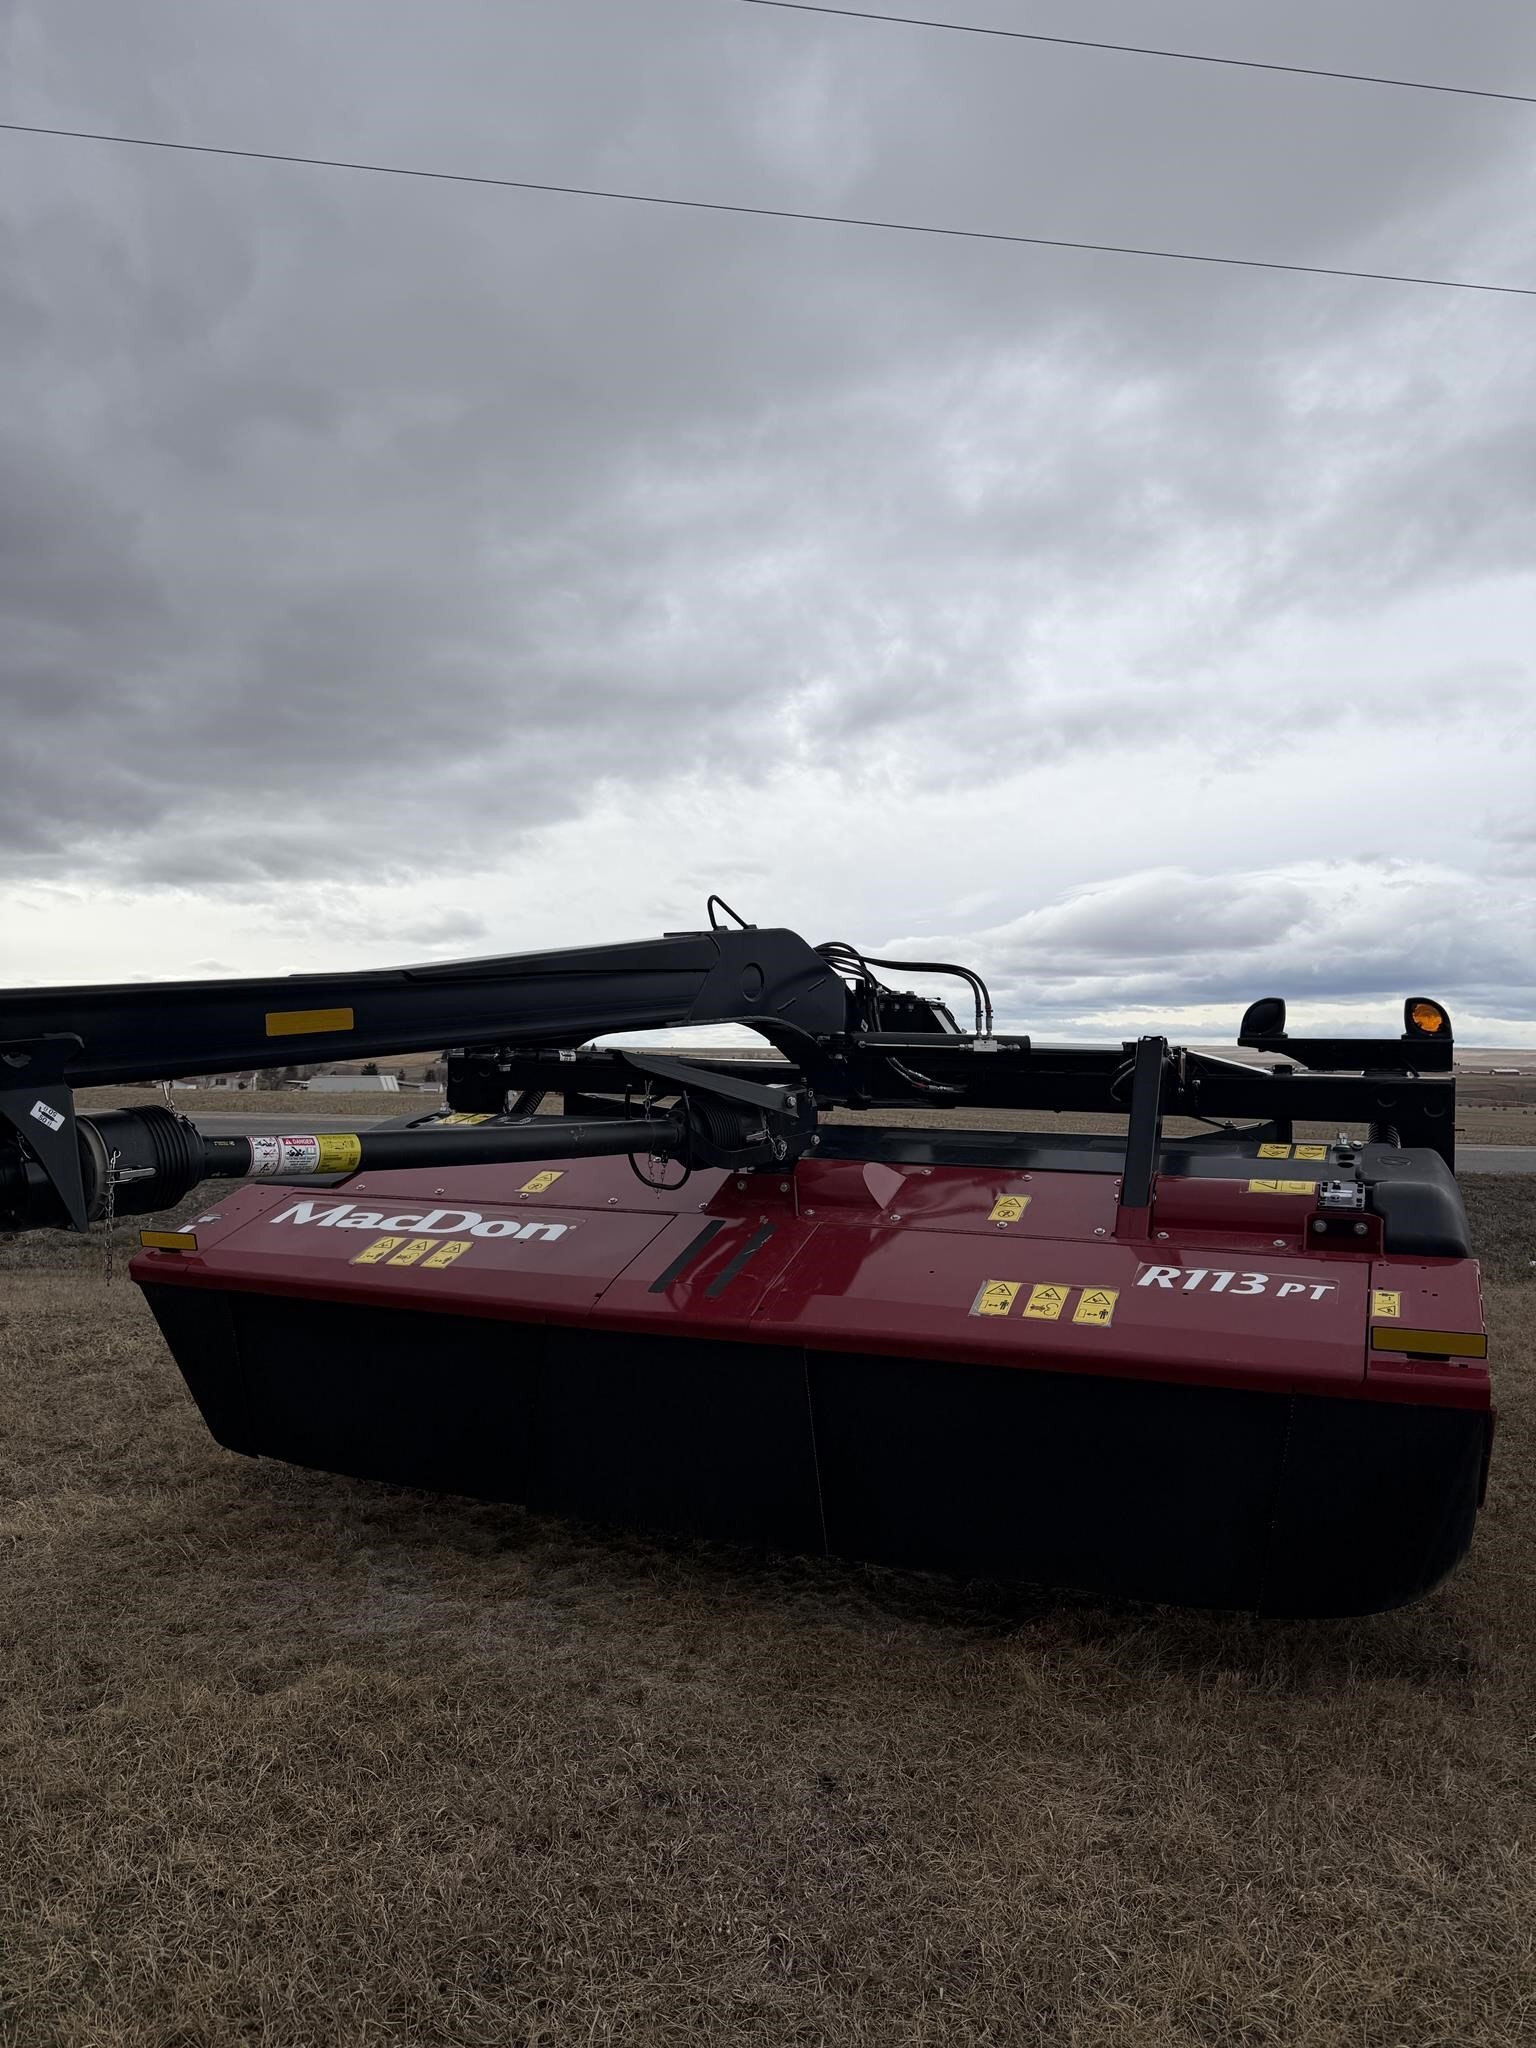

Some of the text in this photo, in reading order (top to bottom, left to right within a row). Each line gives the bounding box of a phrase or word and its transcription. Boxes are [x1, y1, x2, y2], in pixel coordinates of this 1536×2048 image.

[270, 1201, 569, 1241] MacDon
[1137, 1266, 1336, 1300] R113 PT
